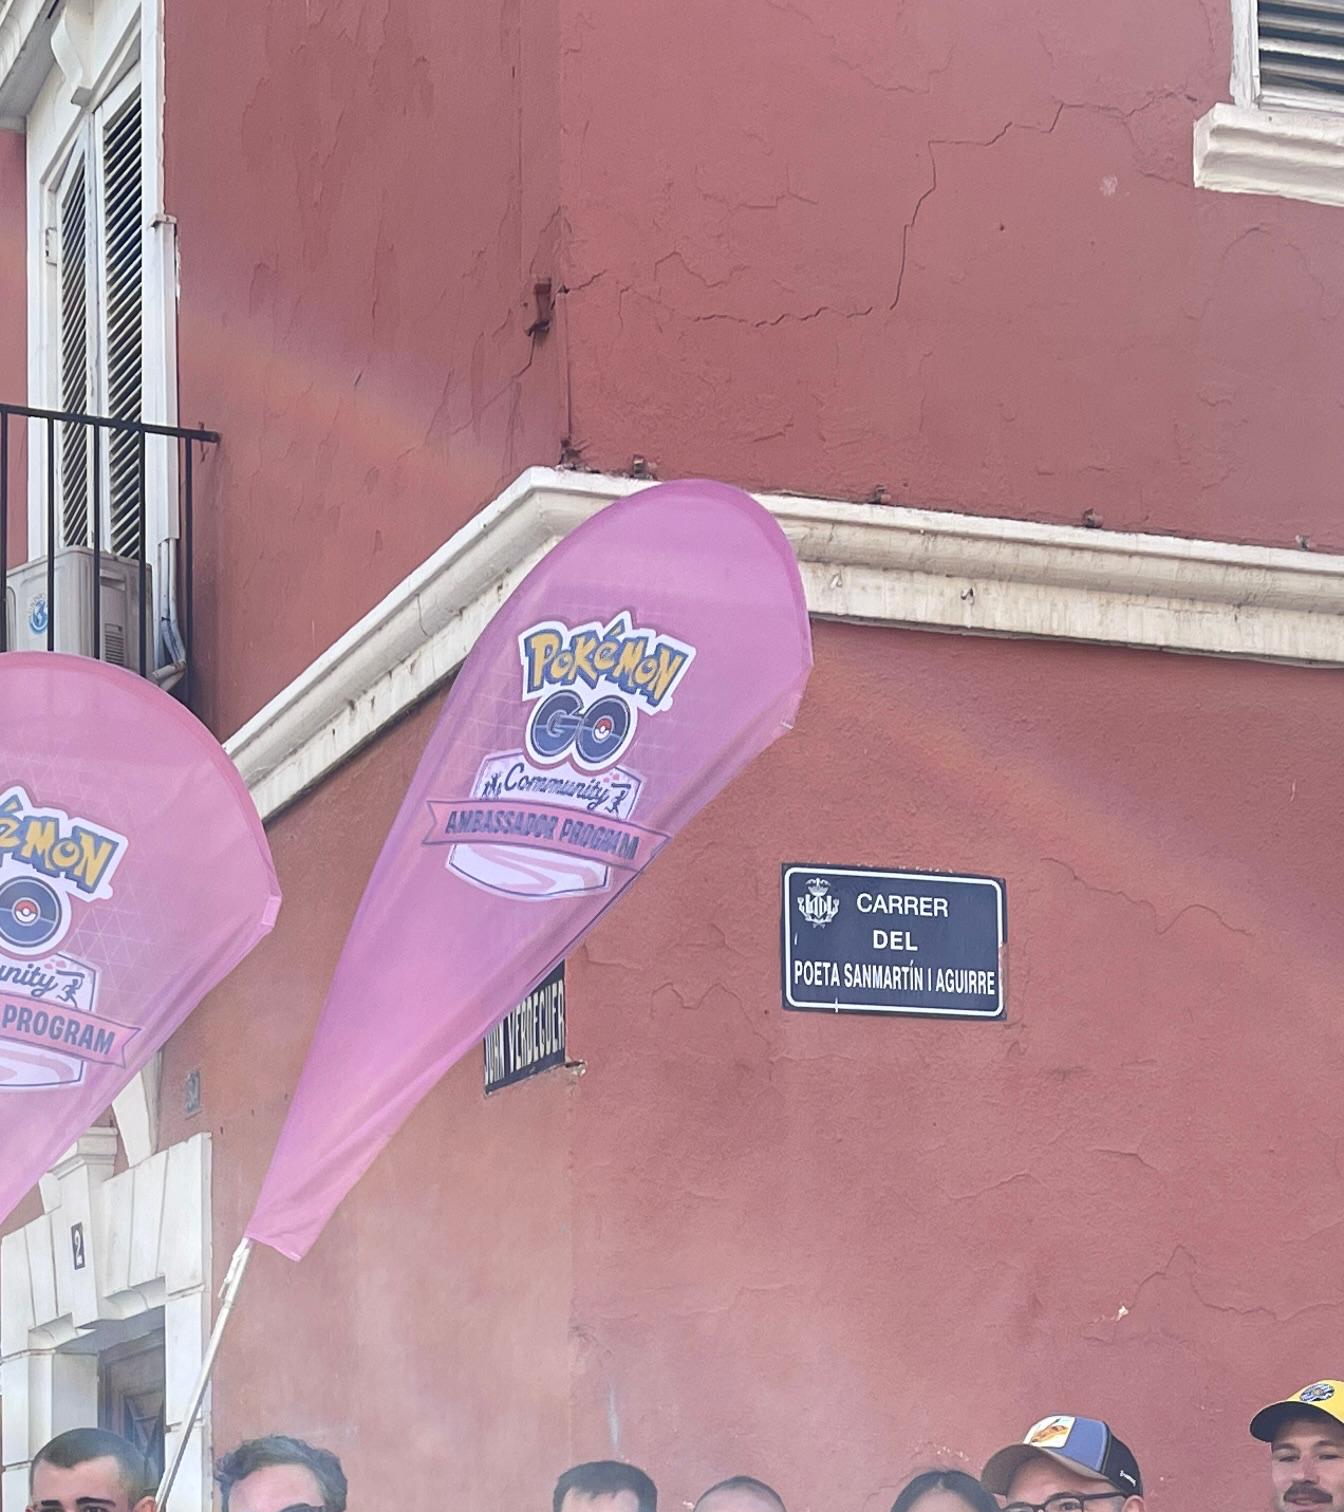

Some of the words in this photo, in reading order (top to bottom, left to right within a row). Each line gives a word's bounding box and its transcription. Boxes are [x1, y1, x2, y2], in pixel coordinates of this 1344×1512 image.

[524, 618, 689, 707] Pokémon
[531, 689, 631, 763] GO
[505, 763, 610, 810] Community
[445, 810, 558, 840] AMBASSADOR
[559, 818, 640, 860] PROGRAM
[856, 892, 949, 918] CARRER
[872, 929, 918, 951] DEL
[794, 960, 840, 987] POETA
[844, 959, 923, 991] SANMARTÍN
[927, 968, 932, 991] I
[935, 969, 995, 995] AGUIRRE
[2, 1004, 115, 1055] PROGRAM
[74, 1230, 84, 1266] 2
